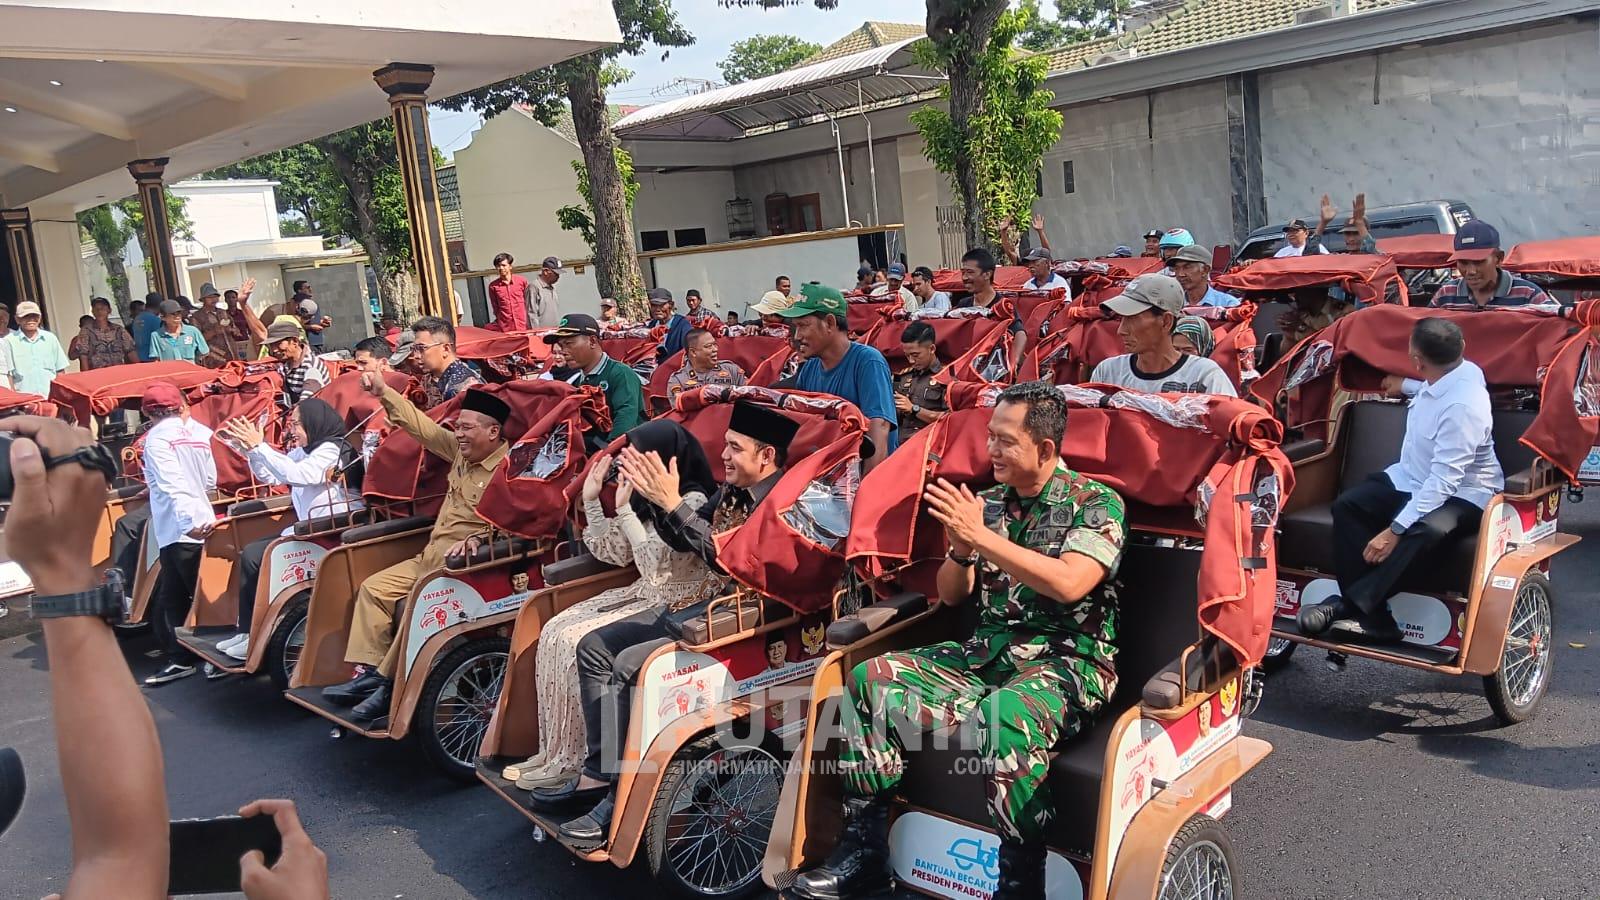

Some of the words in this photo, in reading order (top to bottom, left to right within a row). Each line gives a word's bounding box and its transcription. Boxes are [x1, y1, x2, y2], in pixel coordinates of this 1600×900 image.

[422, 588, 455, 601] YAYASAN
[1406, 623, 1424, 632] DARI
[661, 664, 699, 682] YAYASAN
[915, 858, 956, 878] BANTUAN
[957, 873, 987, 889] BECAK
[911, 868, 951, 889] PRESIDEN
[952, 882, 992, 900] PRABOW
